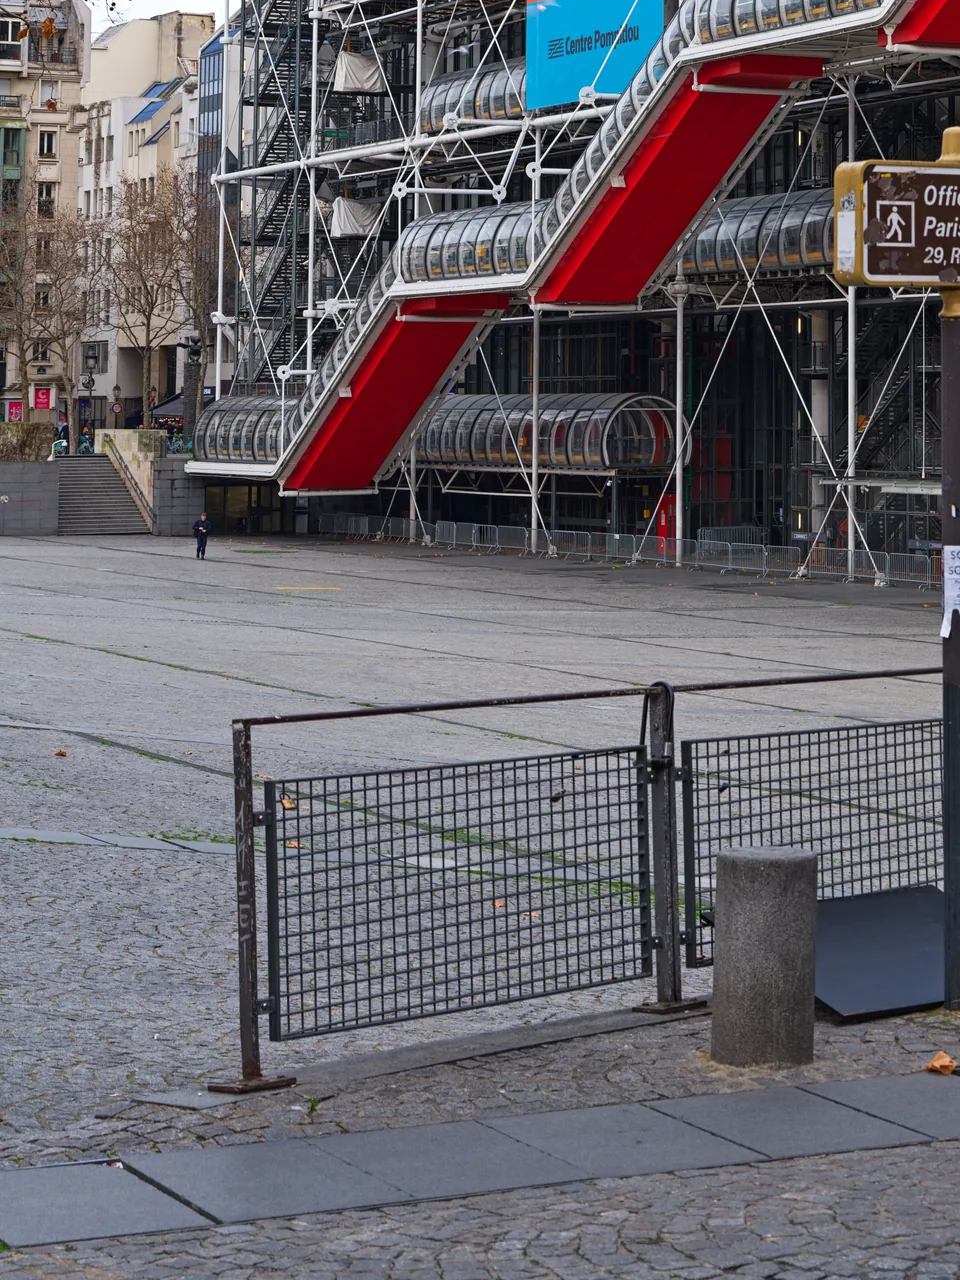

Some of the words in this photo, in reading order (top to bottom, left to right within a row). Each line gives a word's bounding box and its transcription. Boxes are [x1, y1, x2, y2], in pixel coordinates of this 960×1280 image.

[565, 35, 592, 55] Centre
[594, 23, 639, 49] Pompidou
[923, 247, 947, 266] 29,
